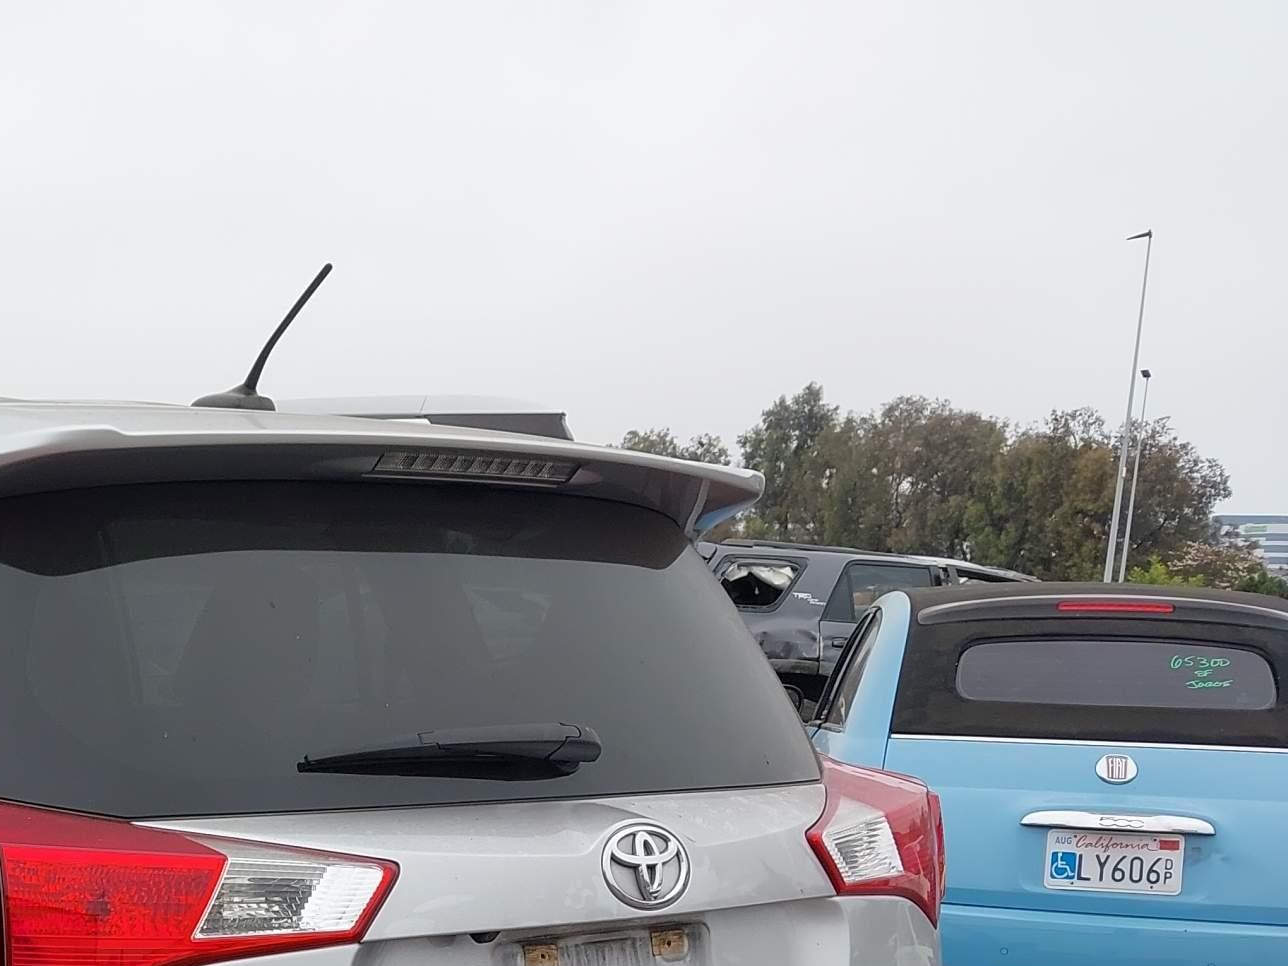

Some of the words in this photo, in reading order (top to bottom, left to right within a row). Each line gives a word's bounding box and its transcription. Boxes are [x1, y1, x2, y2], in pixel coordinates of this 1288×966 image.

[1098, 816, 1144, 829] 500
[1055, 836, 1073, 845] AUG
[1075, 834, 1158, 853] California
[1077, 853, 1162, 885] LY606
